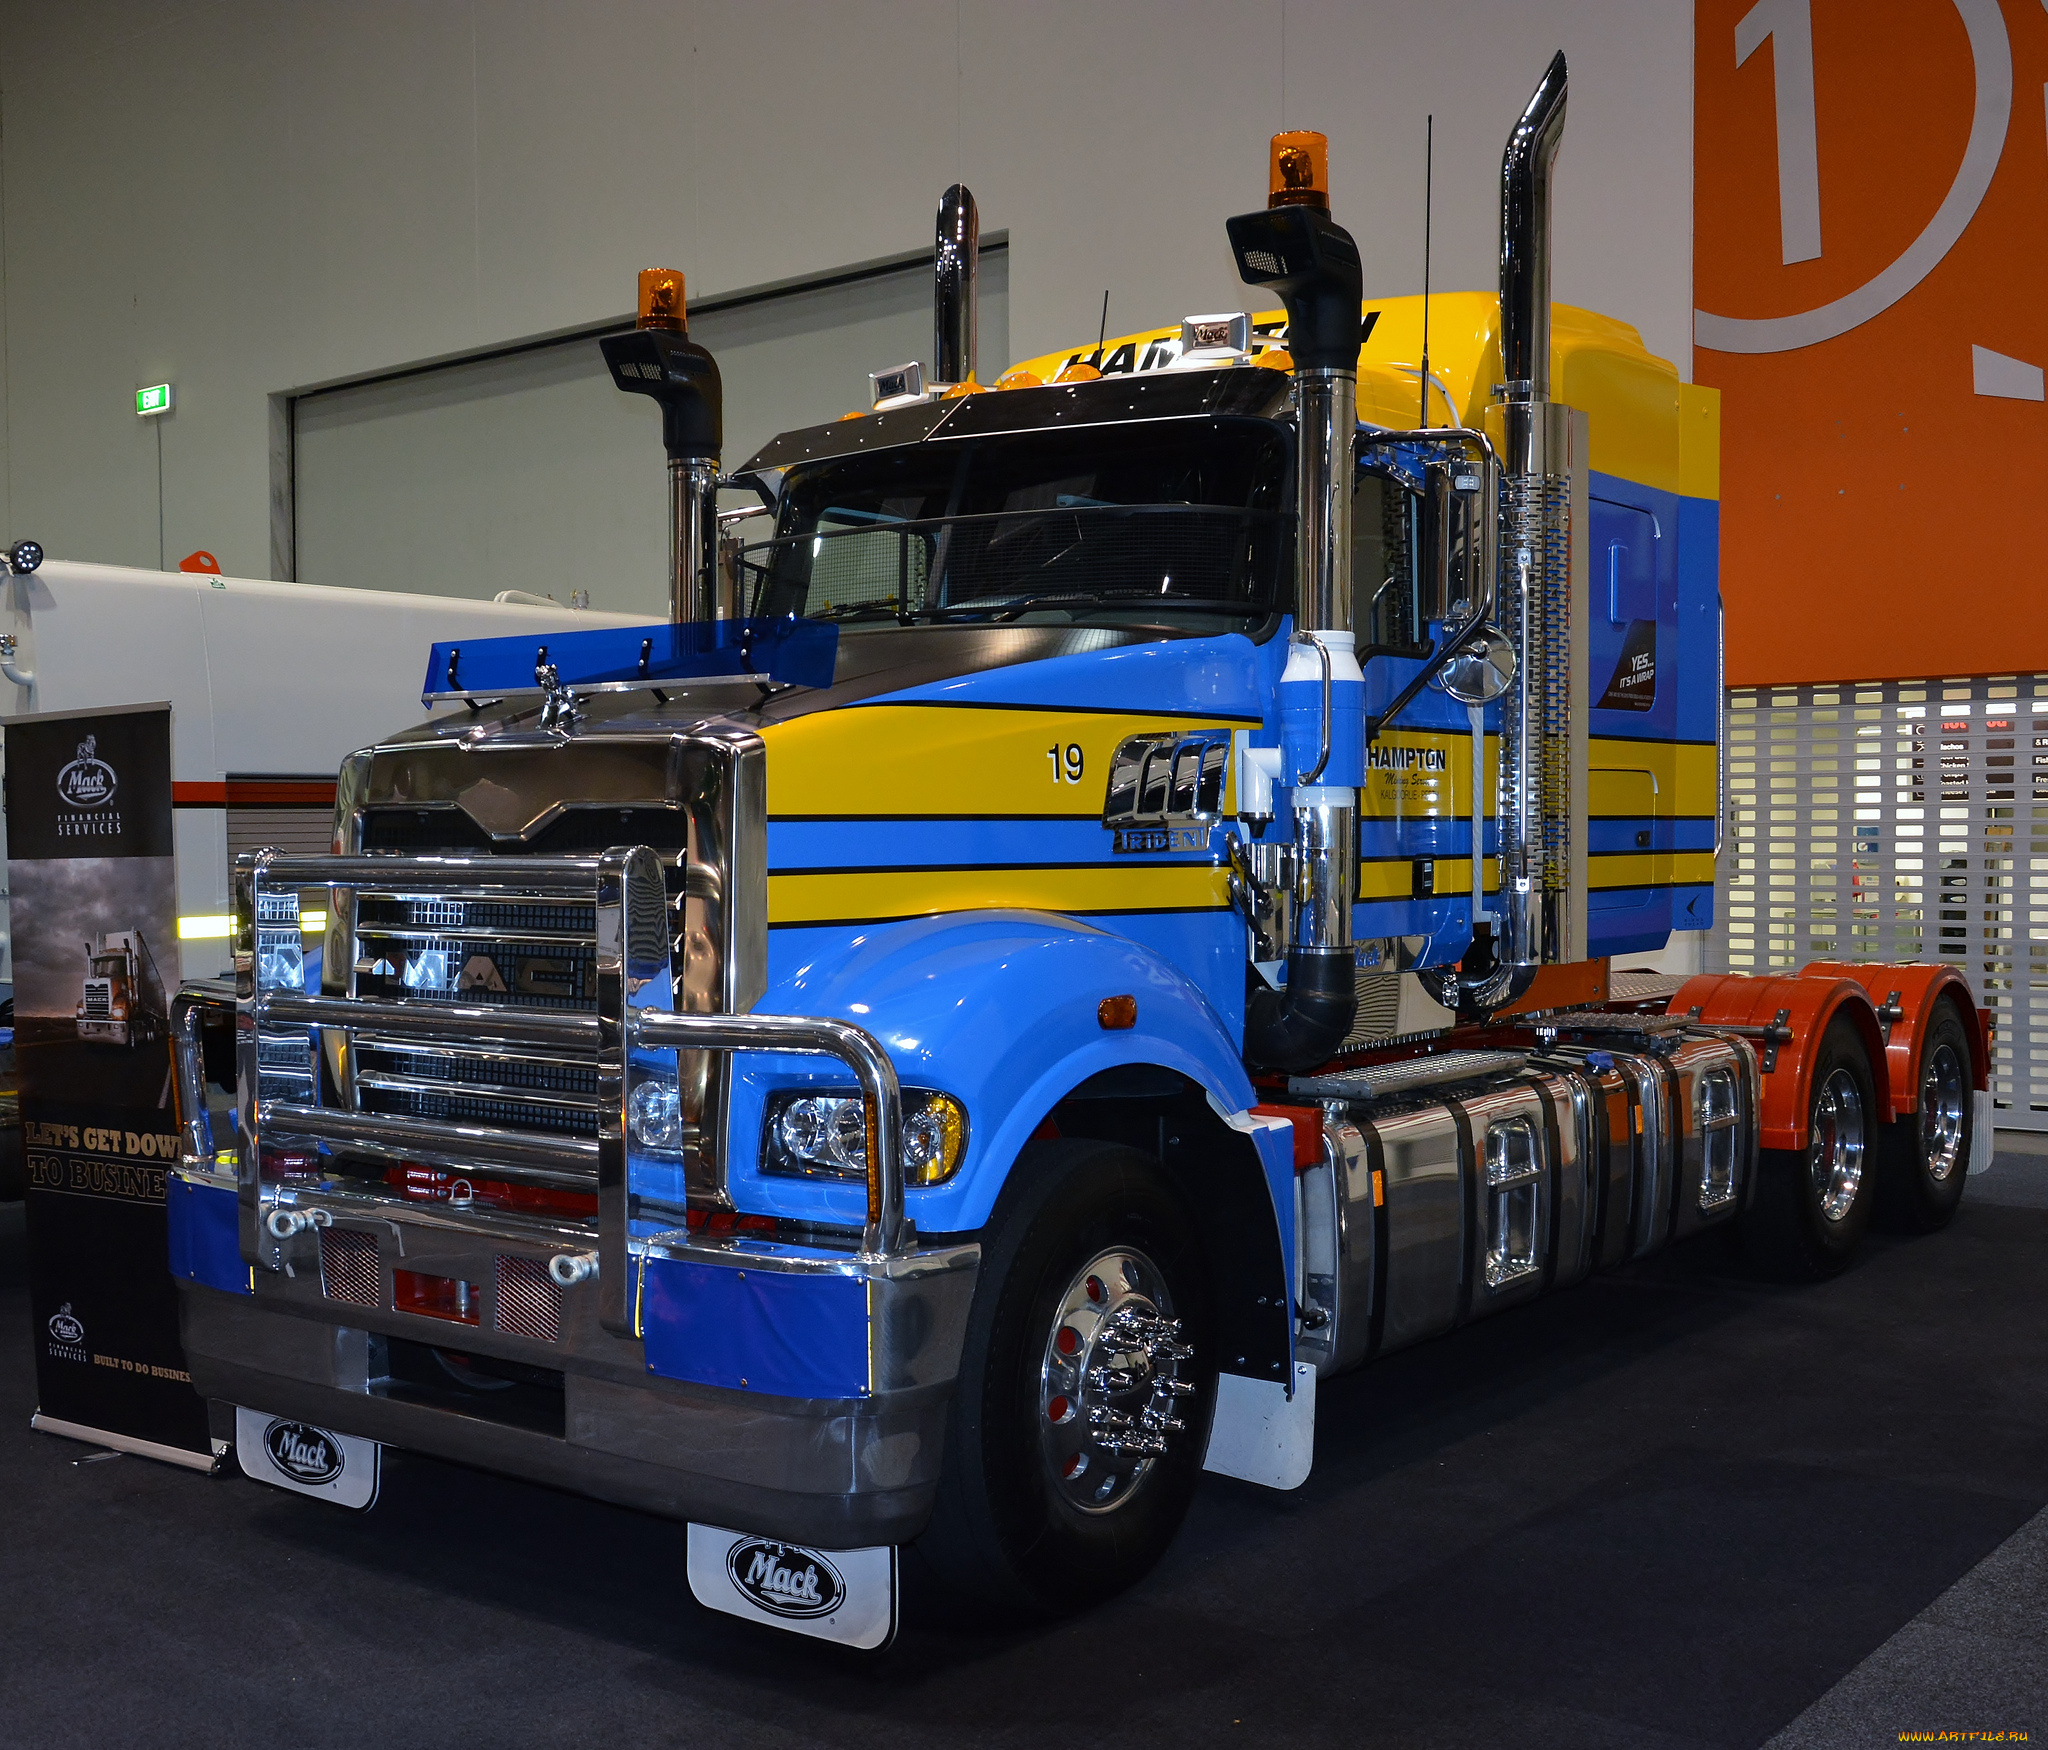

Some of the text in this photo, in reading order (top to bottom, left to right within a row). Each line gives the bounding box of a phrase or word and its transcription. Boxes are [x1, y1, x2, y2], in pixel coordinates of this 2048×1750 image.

[1194, 326, 1228, 343] Mack
[1636, 669, 1655, 684] WRAP
[1047, 743, 1084, 785] 19
[1365, 746, 1446, 772] HAMPTON
[67, 768, 107, 800] Mack
[57, 812, 120, 822] FINANCIAL
[58, 822, 121, 836] SERVICES
[25, 1121, 79, 1148] LET'S
[83, 1127, 121, 1153] GET
[27, 1154, 63, 1186] TO
[49, 1348, 87, 1362] SERVICES
[93, 1353, 192, 1383] BUILT TO DO BUSINES
[276, 1430, 329, 1473] Mack
[744, 1551, 822, 1606] Mack
